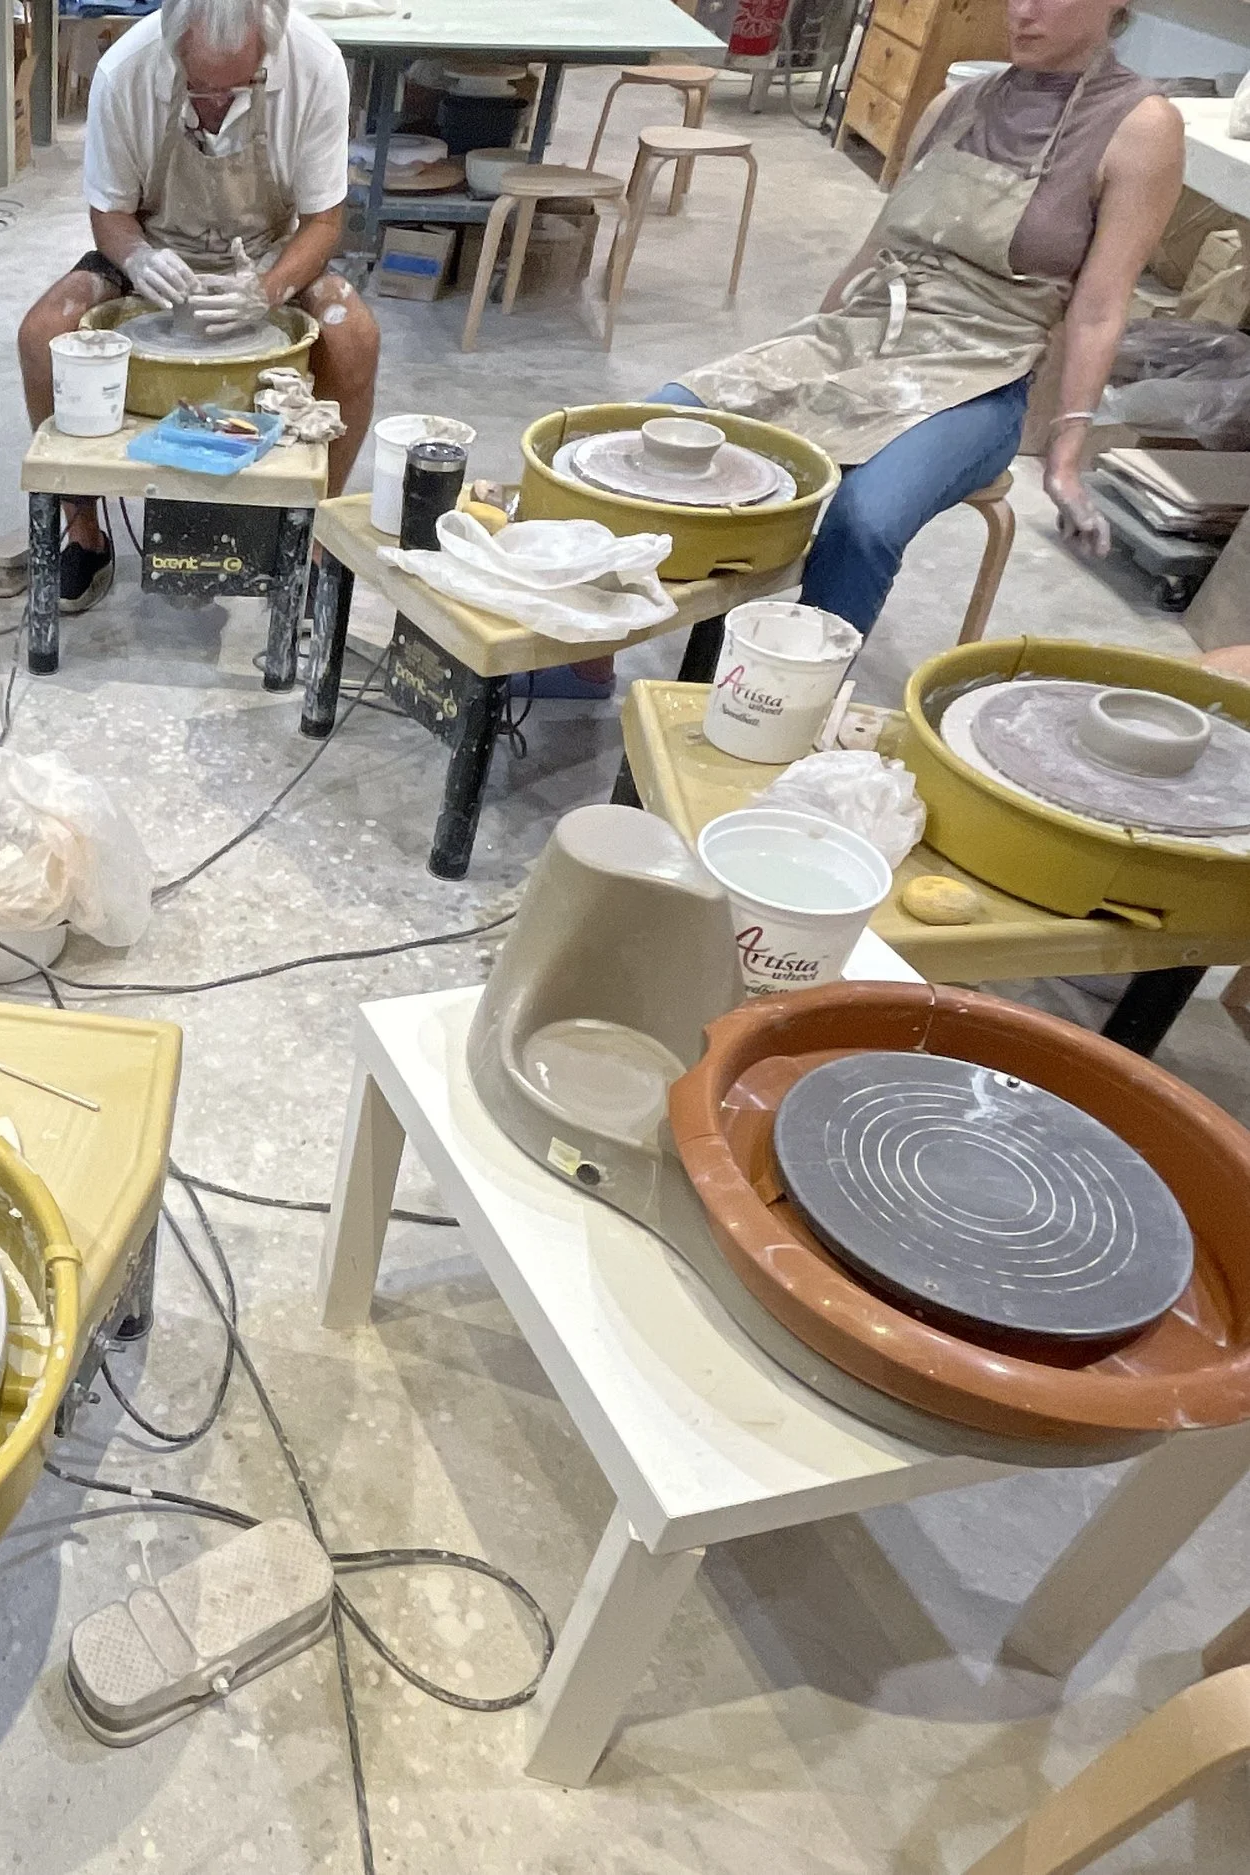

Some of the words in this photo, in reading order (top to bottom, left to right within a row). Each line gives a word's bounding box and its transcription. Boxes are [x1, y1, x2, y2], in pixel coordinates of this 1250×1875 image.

[152, 555, 198, 570] brent
[395, 660, 427, 697] brent
[717, 664, 783, 708] Artista
[748, 702, 784, 716] wheel
[735, 925, 820, 976] Artista
[771, 970, 819, 981] wheel
